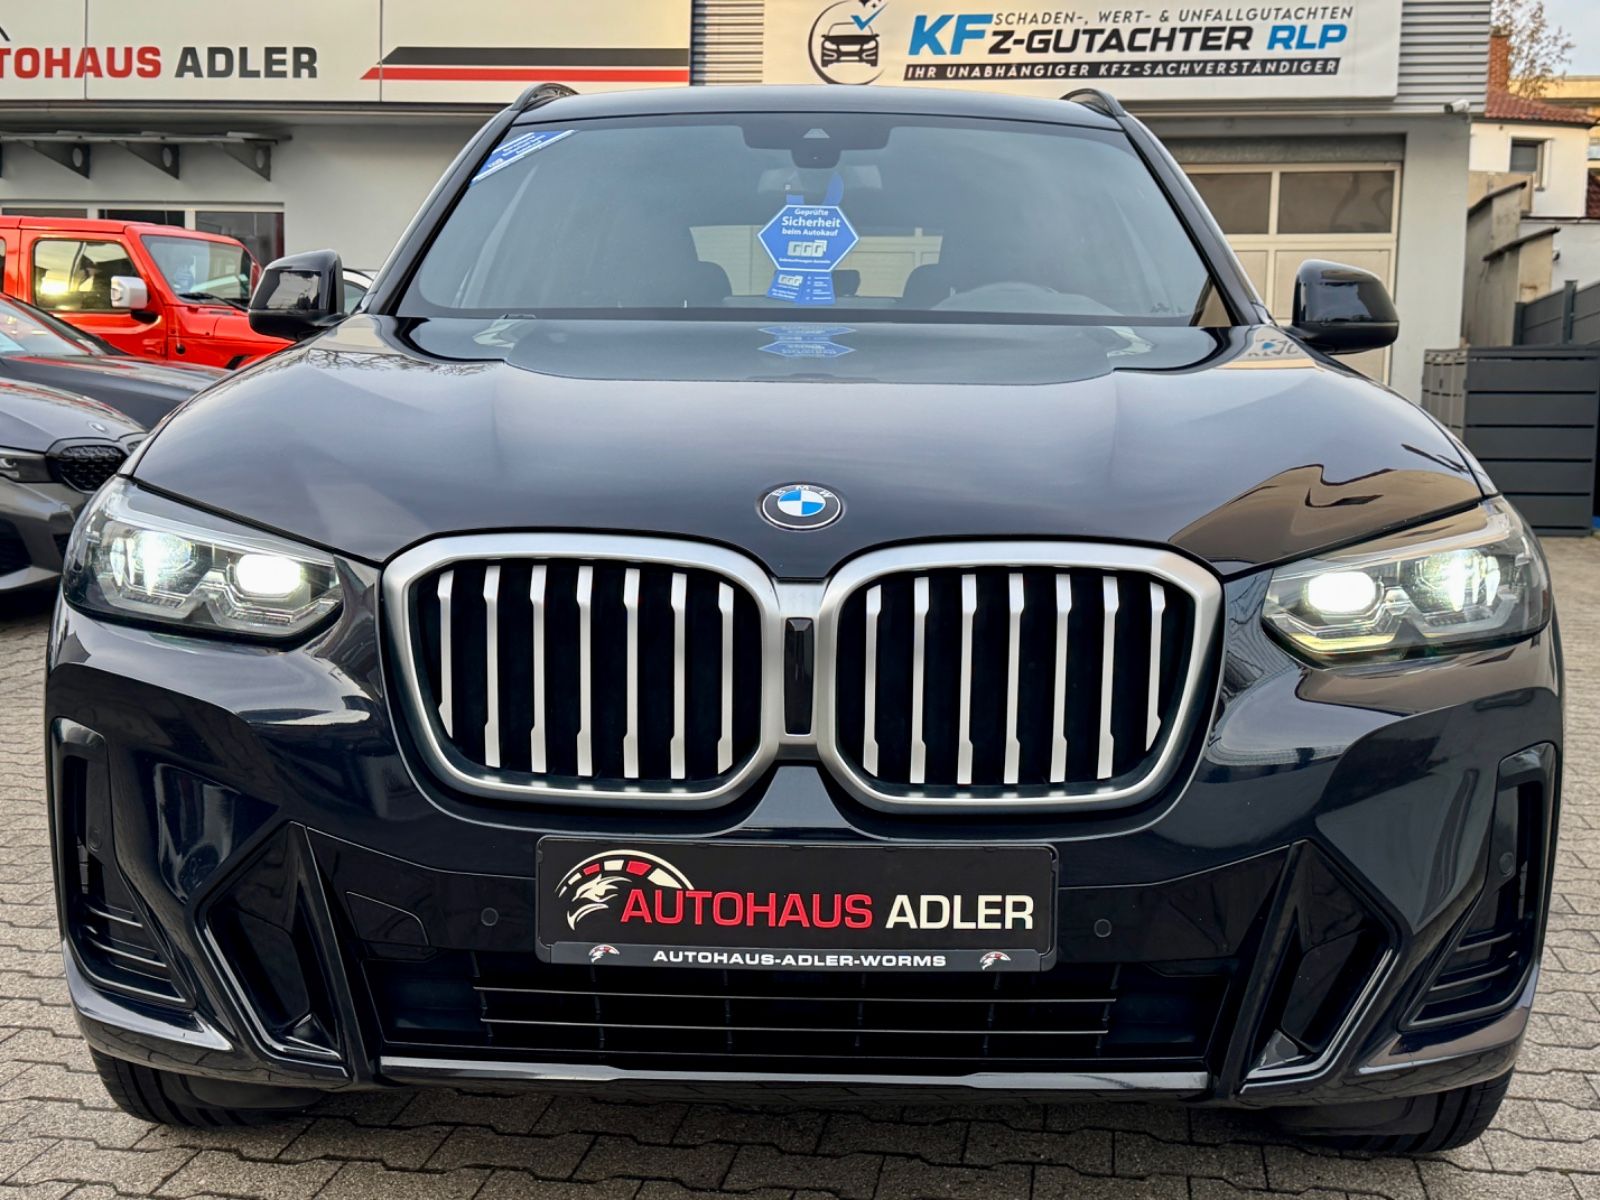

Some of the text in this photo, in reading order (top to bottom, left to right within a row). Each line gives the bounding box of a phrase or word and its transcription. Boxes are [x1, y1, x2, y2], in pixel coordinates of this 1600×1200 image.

[994, 6, 1354, 26] SCHADEN-, WERT- & UNFALLGUTACHTEN
[1267, 24, 1348, 50] RLP
[175, 46, 317, 79] ADLER
[907, 59, 1337, 79] IHR UNABHÄNGIGER KFZ-SACHVERSTÄNDIGER
[781, 216, 841, 228] Sicherheit
[794, 208, 829, 216] Geprüfte
[803, 228, 839, 237] Autokauf
[620, 888, 1034, 930] AUTOHAUS ADLER
[653, 950, 947, 968] AUTOHAUS-ADLER-WORMS
